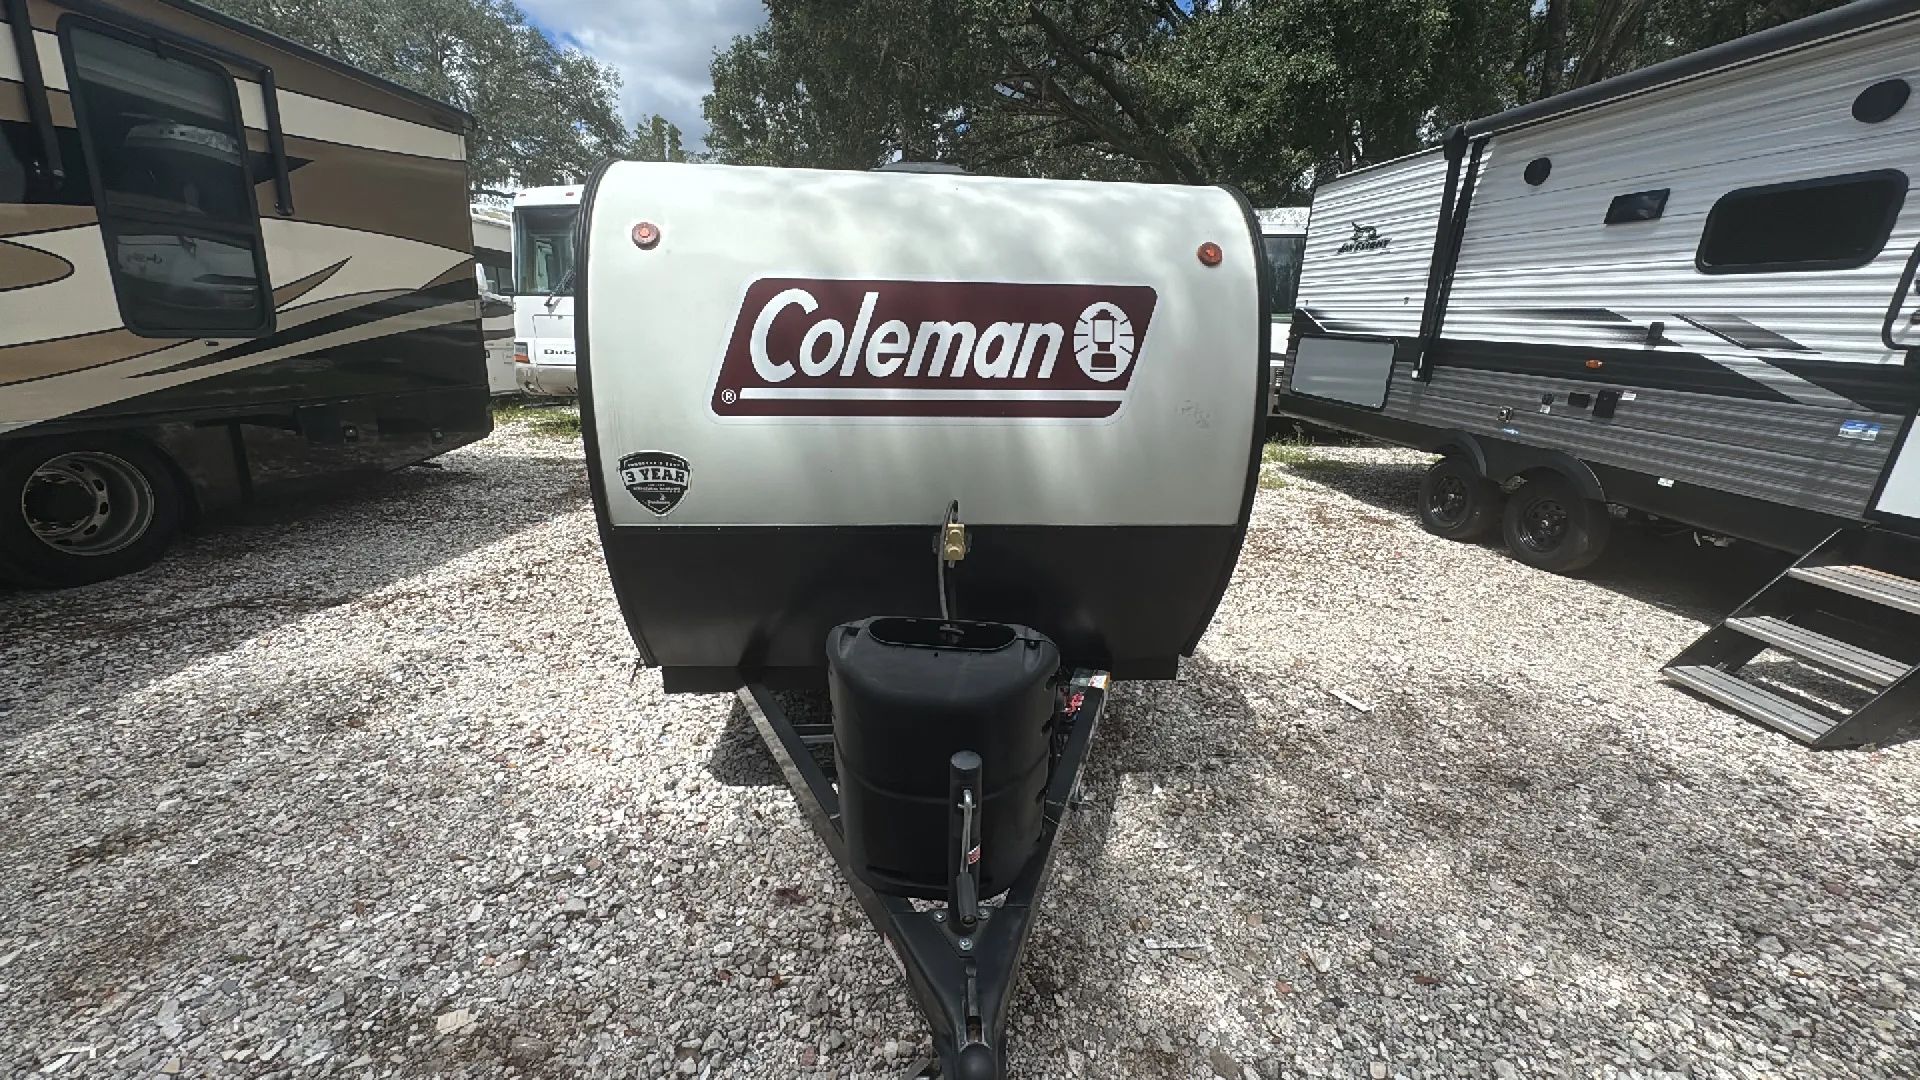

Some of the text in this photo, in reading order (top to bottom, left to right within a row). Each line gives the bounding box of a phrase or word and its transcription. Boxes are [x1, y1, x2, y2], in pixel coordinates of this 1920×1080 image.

[750, 288, 1065, 383] Coleman
[625, 467, 685, 483] 3 YEAR
